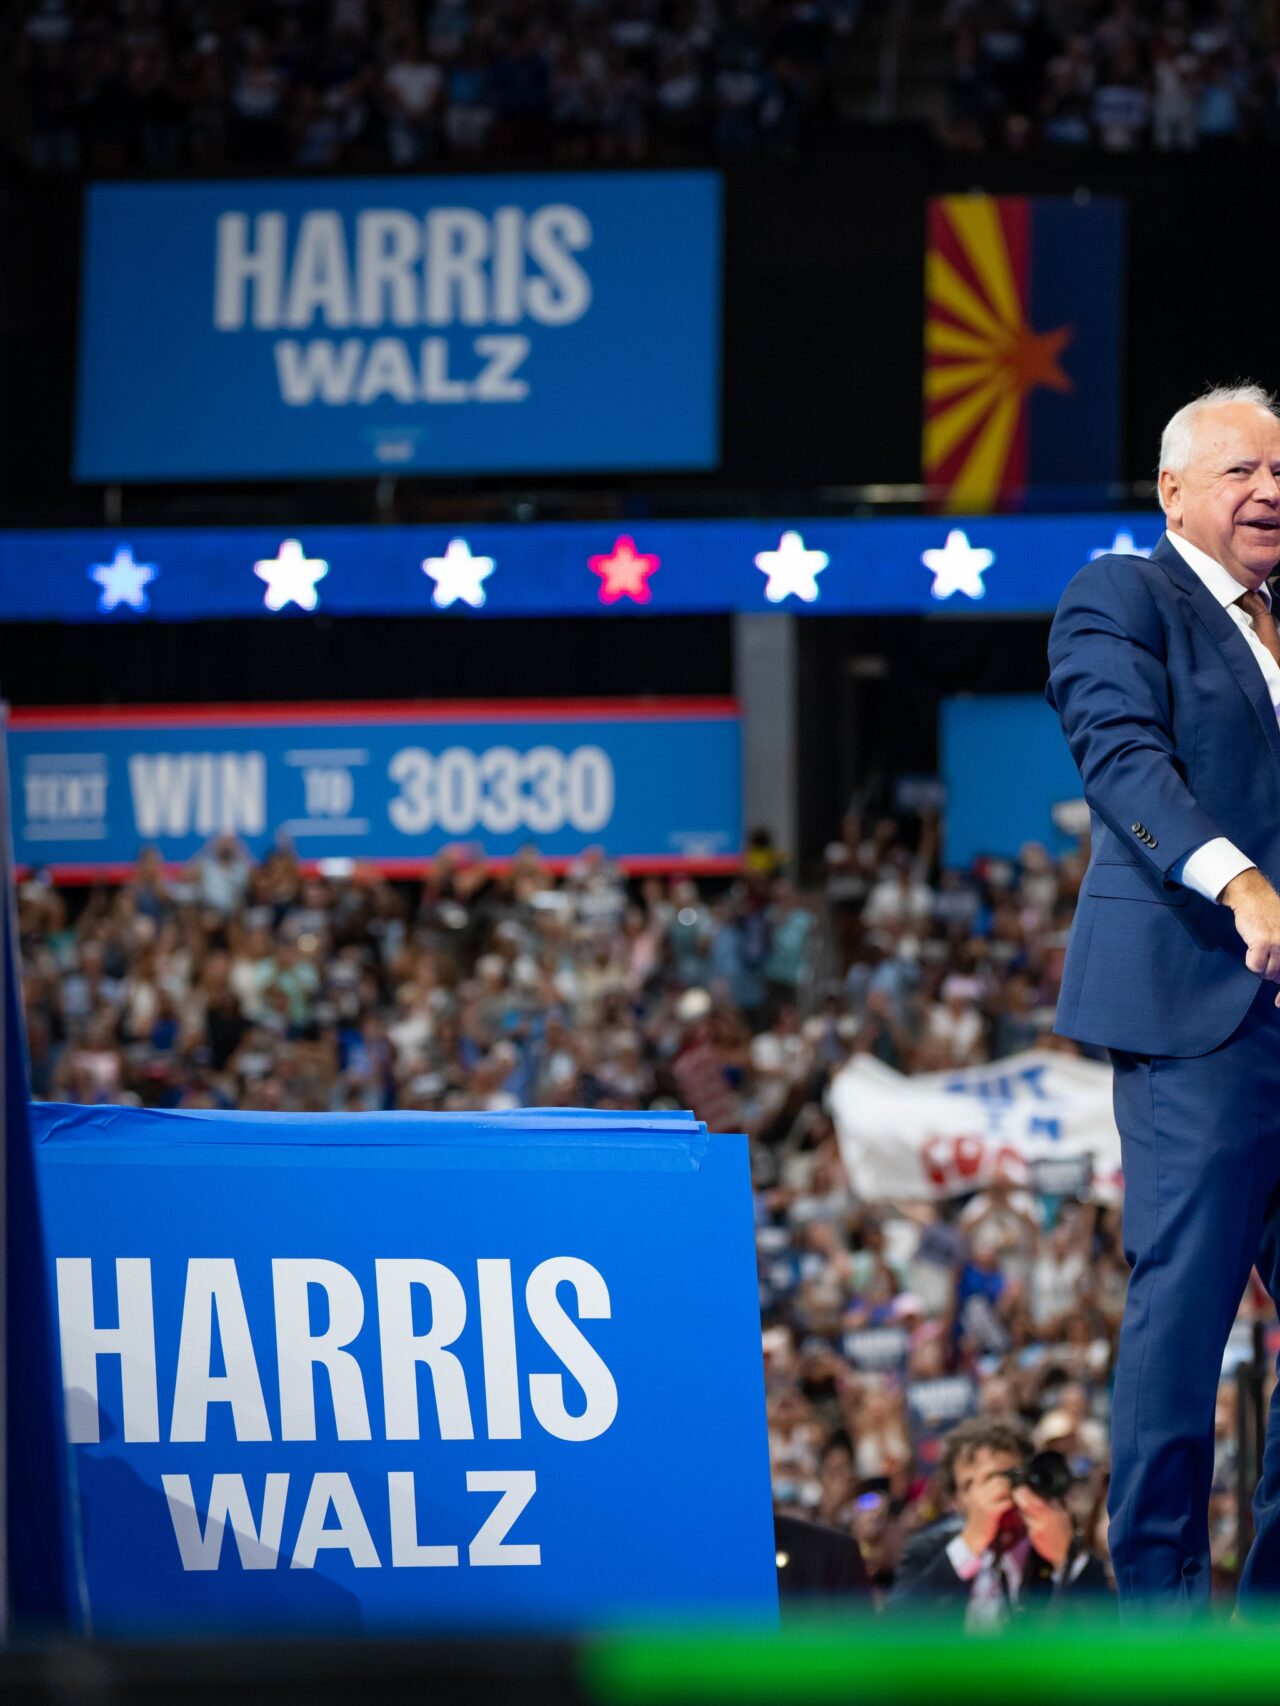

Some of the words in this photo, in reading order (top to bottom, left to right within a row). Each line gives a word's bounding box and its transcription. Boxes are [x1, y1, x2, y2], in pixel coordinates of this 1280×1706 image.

[214, 204, 593, 331] HARRIS
[274, 334, 531, 406] WALZ
[128, 751, 267, 838] WIN
[302, 766, 354, 819] TO
[388, 745, 614, 835] 30330
[56, 1256, 619, 1442] HARRIS
[161, 1470, 542, 1572] WALZ
